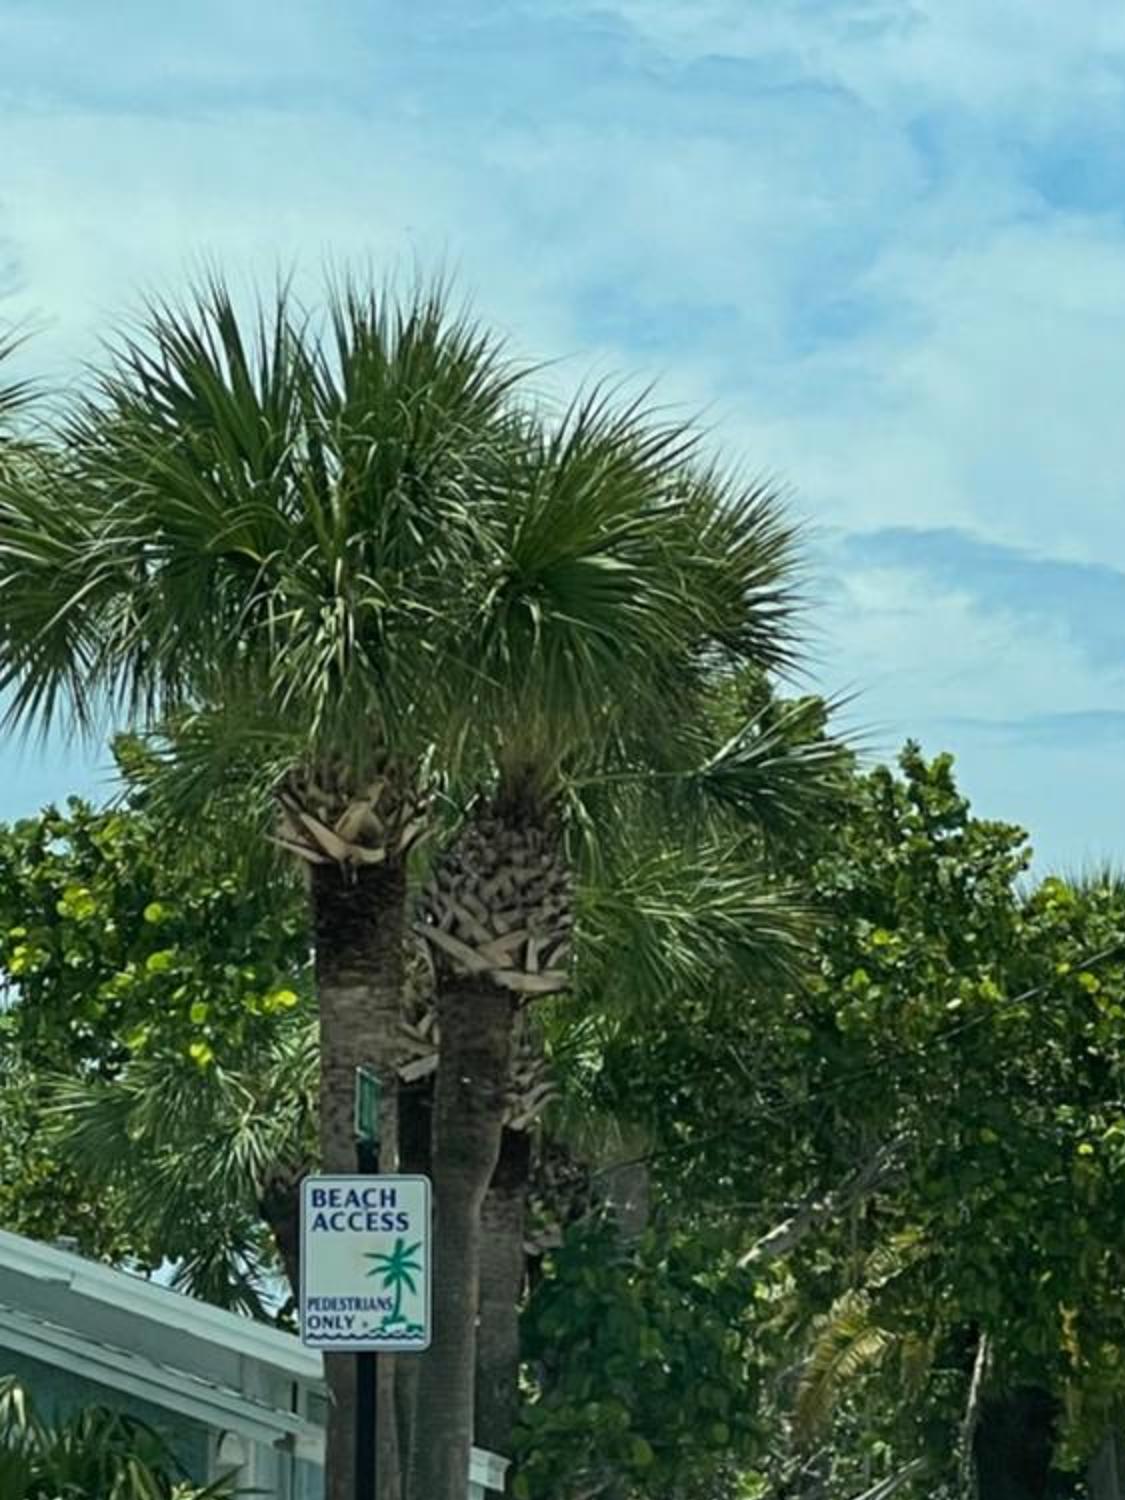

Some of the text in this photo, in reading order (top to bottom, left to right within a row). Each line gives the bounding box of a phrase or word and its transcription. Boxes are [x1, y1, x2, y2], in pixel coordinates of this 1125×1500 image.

[312, 1188, 396, 1208] BEACH
[312, 1212, 409, 1232] ACCESS
[307, 1296, 393, 1311] PEDESTRIANS
[307, 1315, 355, 1330] ONLY
